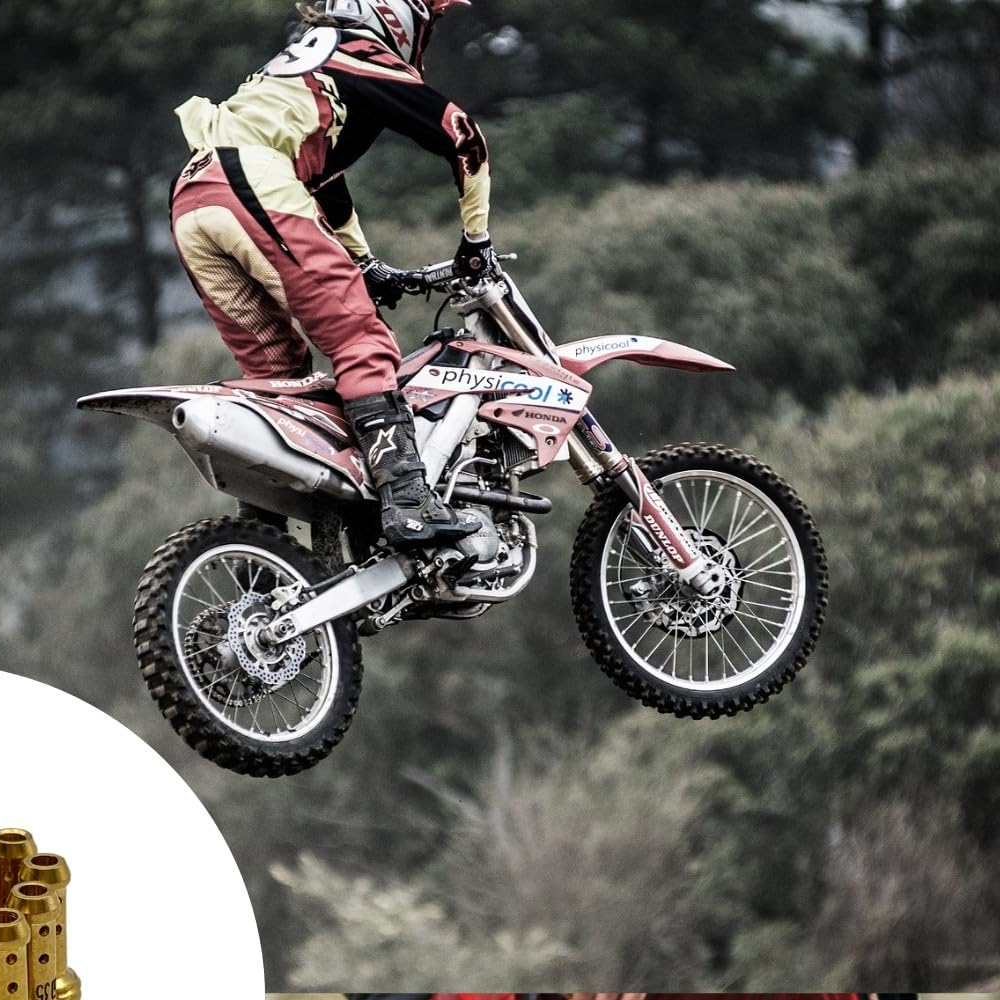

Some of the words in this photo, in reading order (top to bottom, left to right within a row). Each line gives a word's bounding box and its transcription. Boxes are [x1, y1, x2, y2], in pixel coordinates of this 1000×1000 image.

[375, 0, 410, 48] OX
[575, 340, 630, 357] physicool
[269, 371, 327, 388] HONDA
[524, 411, 568, 424] HONDA
[643, 514, 685, 564] DUNLOP
